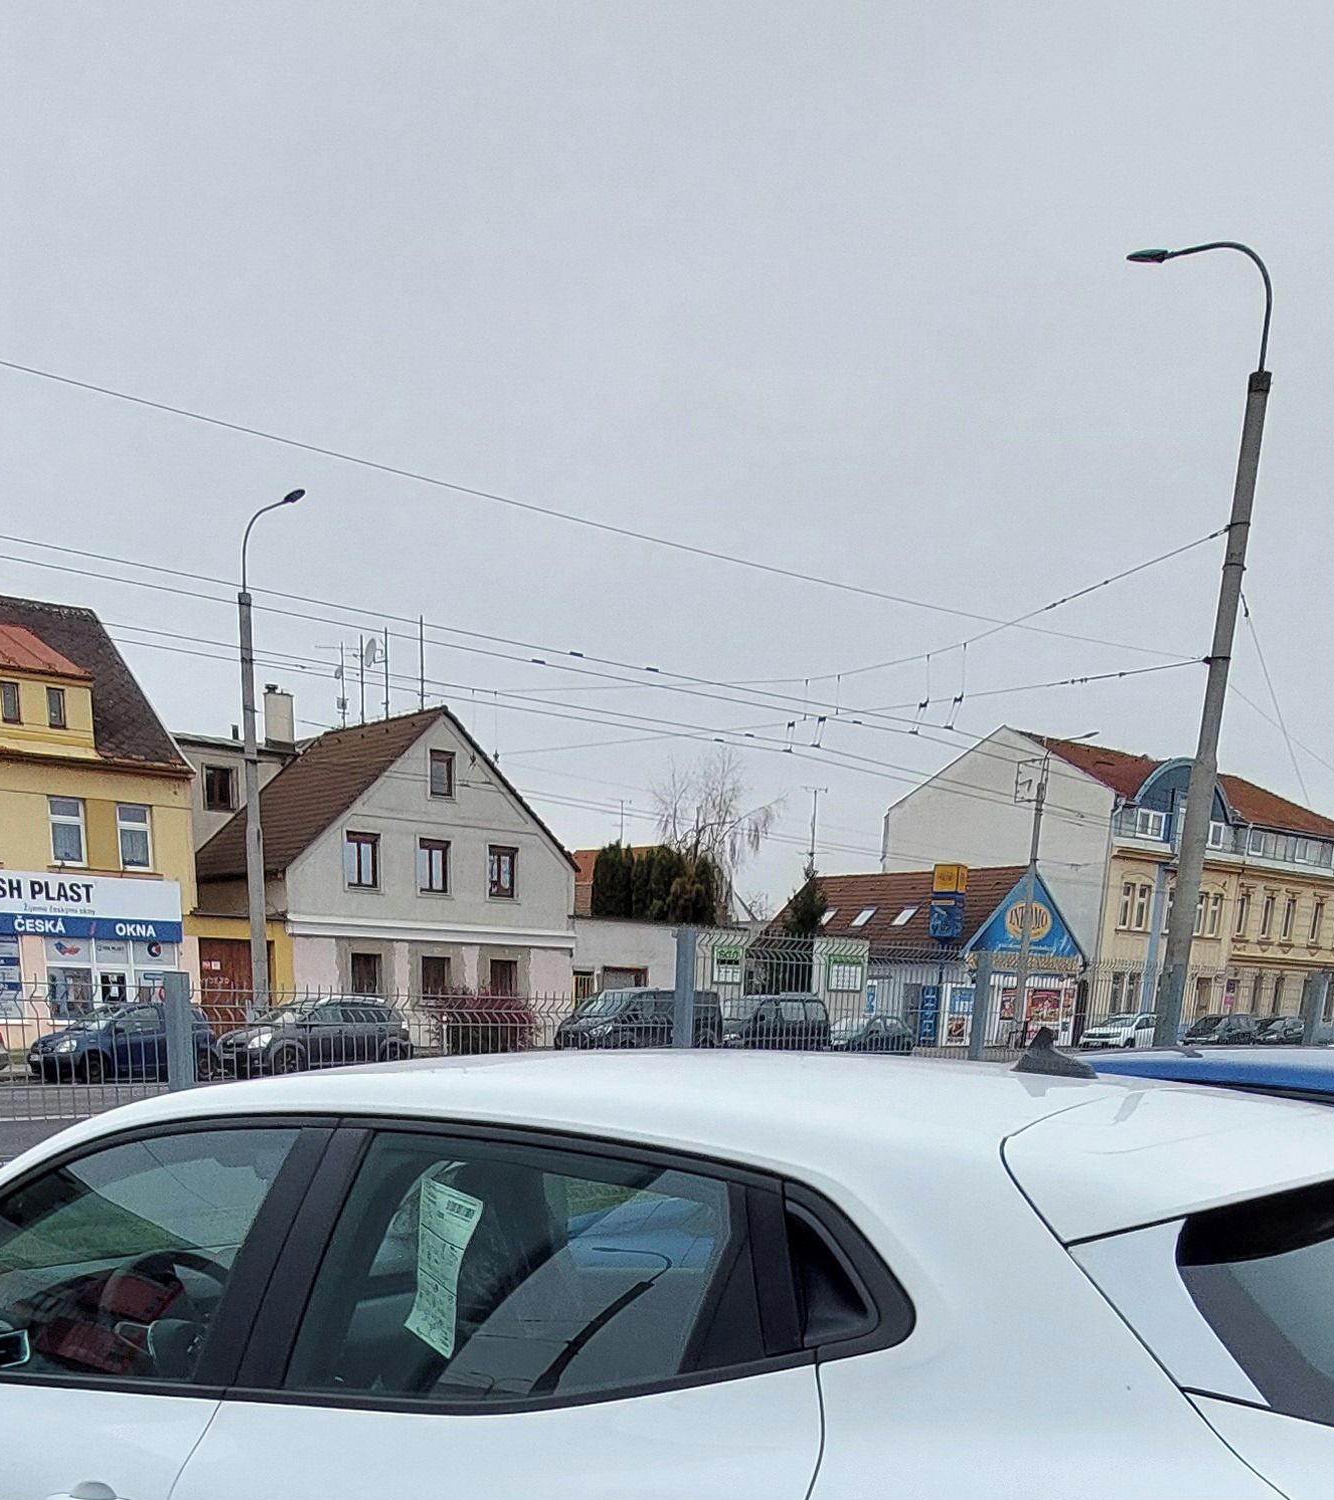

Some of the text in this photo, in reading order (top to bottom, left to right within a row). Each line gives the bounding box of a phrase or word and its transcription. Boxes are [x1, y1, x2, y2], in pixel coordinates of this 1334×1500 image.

[30, 880, 94, 903] PLAST
[14, 915, 66, 934] ČESKÁ
[115, 923, 157, 937] OKNA
